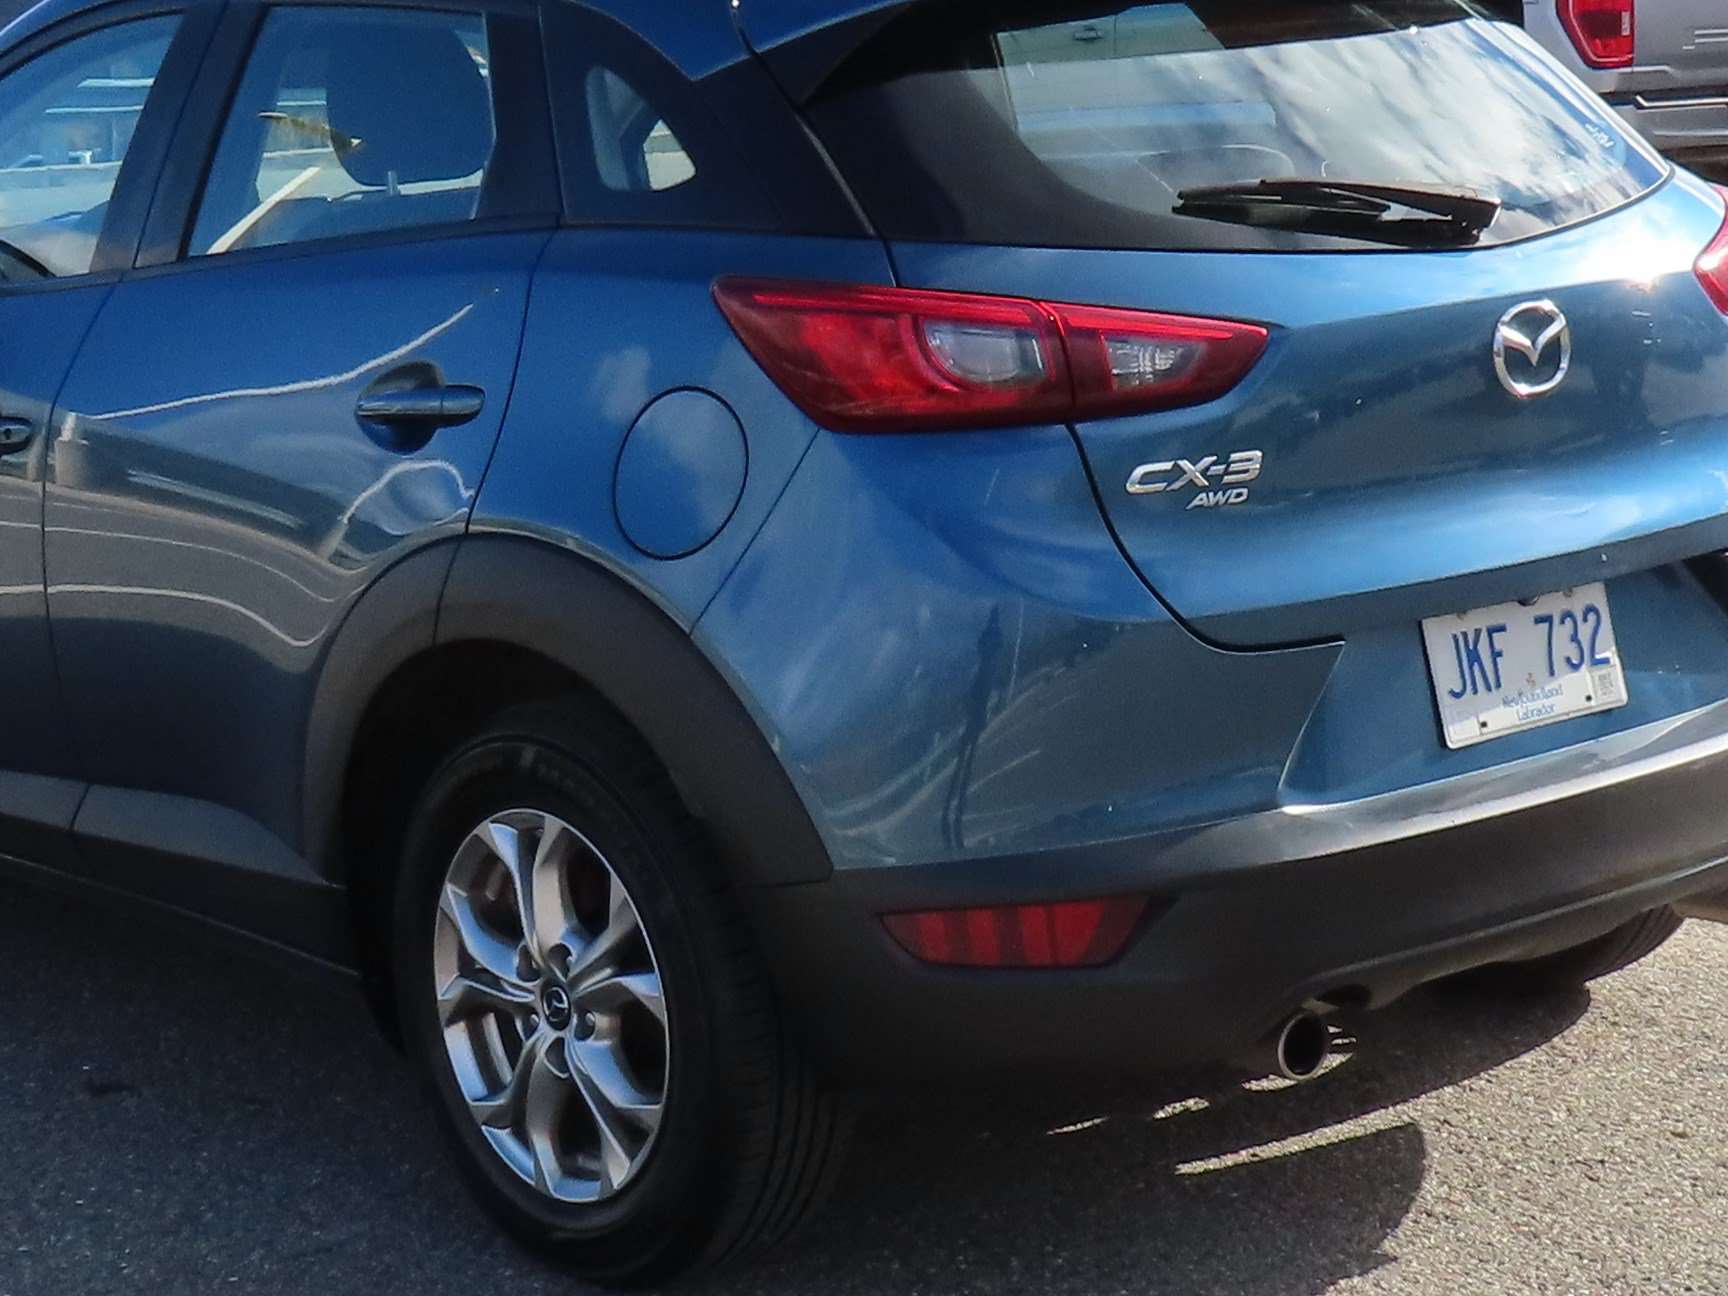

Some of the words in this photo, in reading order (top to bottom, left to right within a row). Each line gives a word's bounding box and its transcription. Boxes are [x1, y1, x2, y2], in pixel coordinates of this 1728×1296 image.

[1125, 449, 1263, 495] CX-3
[1185, 487, 1249, 511] AWD
[1447, 623, 1507, 700] JKF
[1533, 603, 1611, 678] 732
